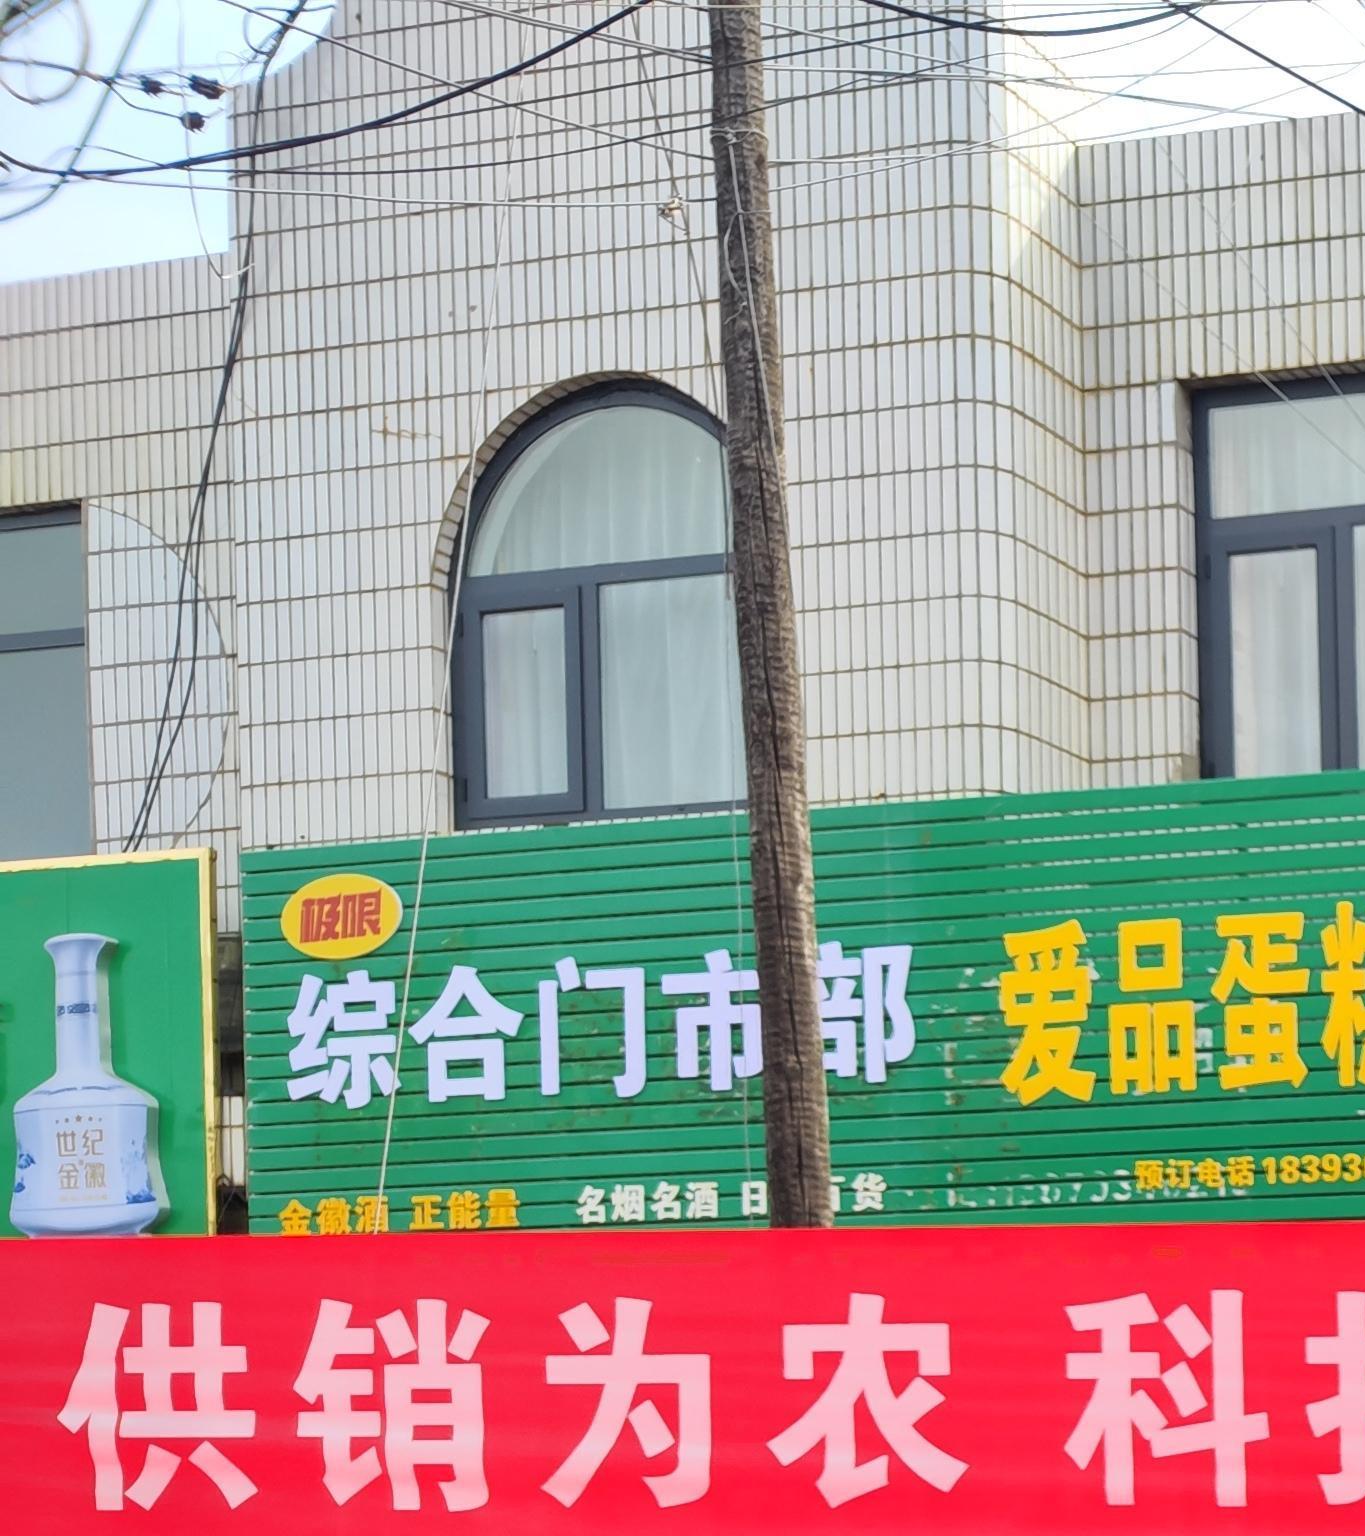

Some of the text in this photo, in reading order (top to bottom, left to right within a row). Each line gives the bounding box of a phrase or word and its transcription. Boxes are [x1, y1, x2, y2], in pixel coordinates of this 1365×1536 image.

[301, 889, 382, 944] 极限
[286, 939, 916, 1110] 综合门市部
[56, 1129, 104, 1157] 世纪
[576, 1172, 888, 1224] 名烟名酒 日货
[1134, 1156, 1256, 1191] 预订电话
[279, 1188, 521, 1236] 金徽酒 正能量
[56, 1291, 969, 1512] 供销为农
